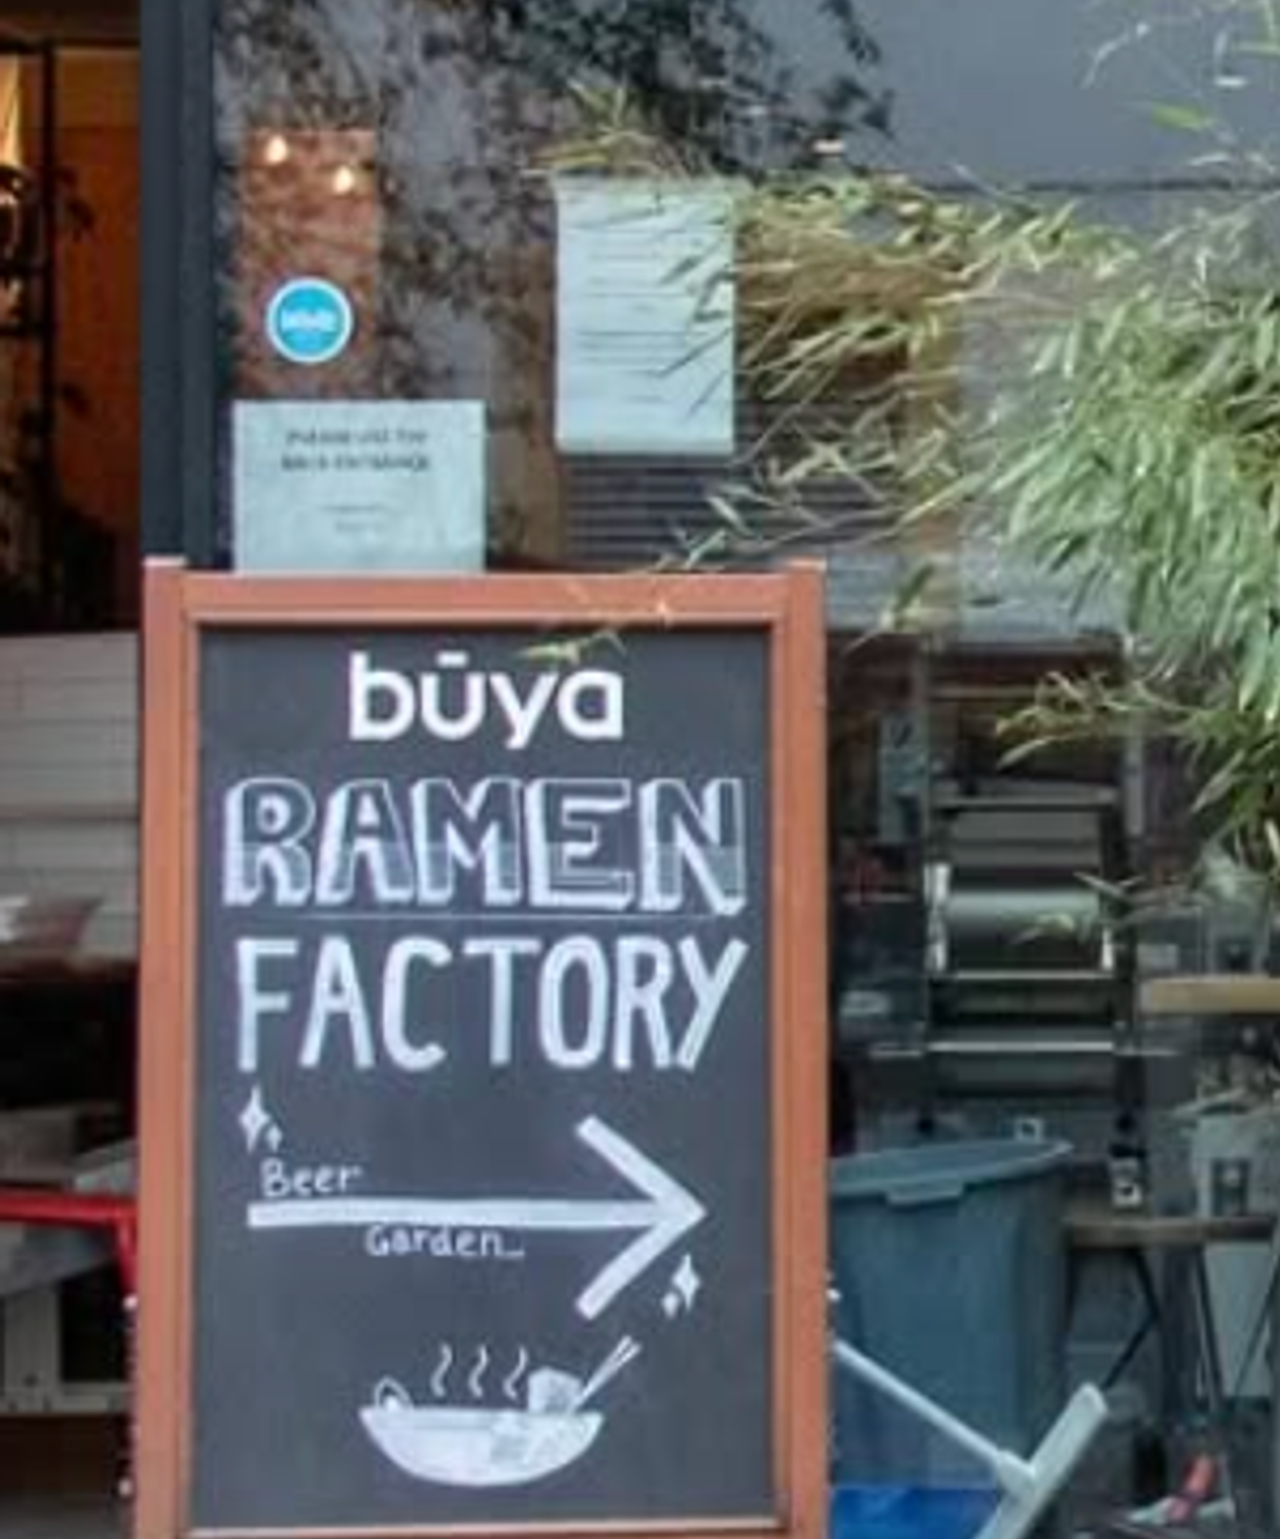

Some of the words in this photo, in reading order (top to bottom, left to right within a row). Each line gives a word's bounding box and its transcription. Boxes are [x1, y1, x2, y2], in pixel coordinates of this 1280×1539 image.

[221, 777, 747, 917] RAMEN
[235, 934, 748, 1071] FACTORY
[260, 1157, 364, 1198] Beer
